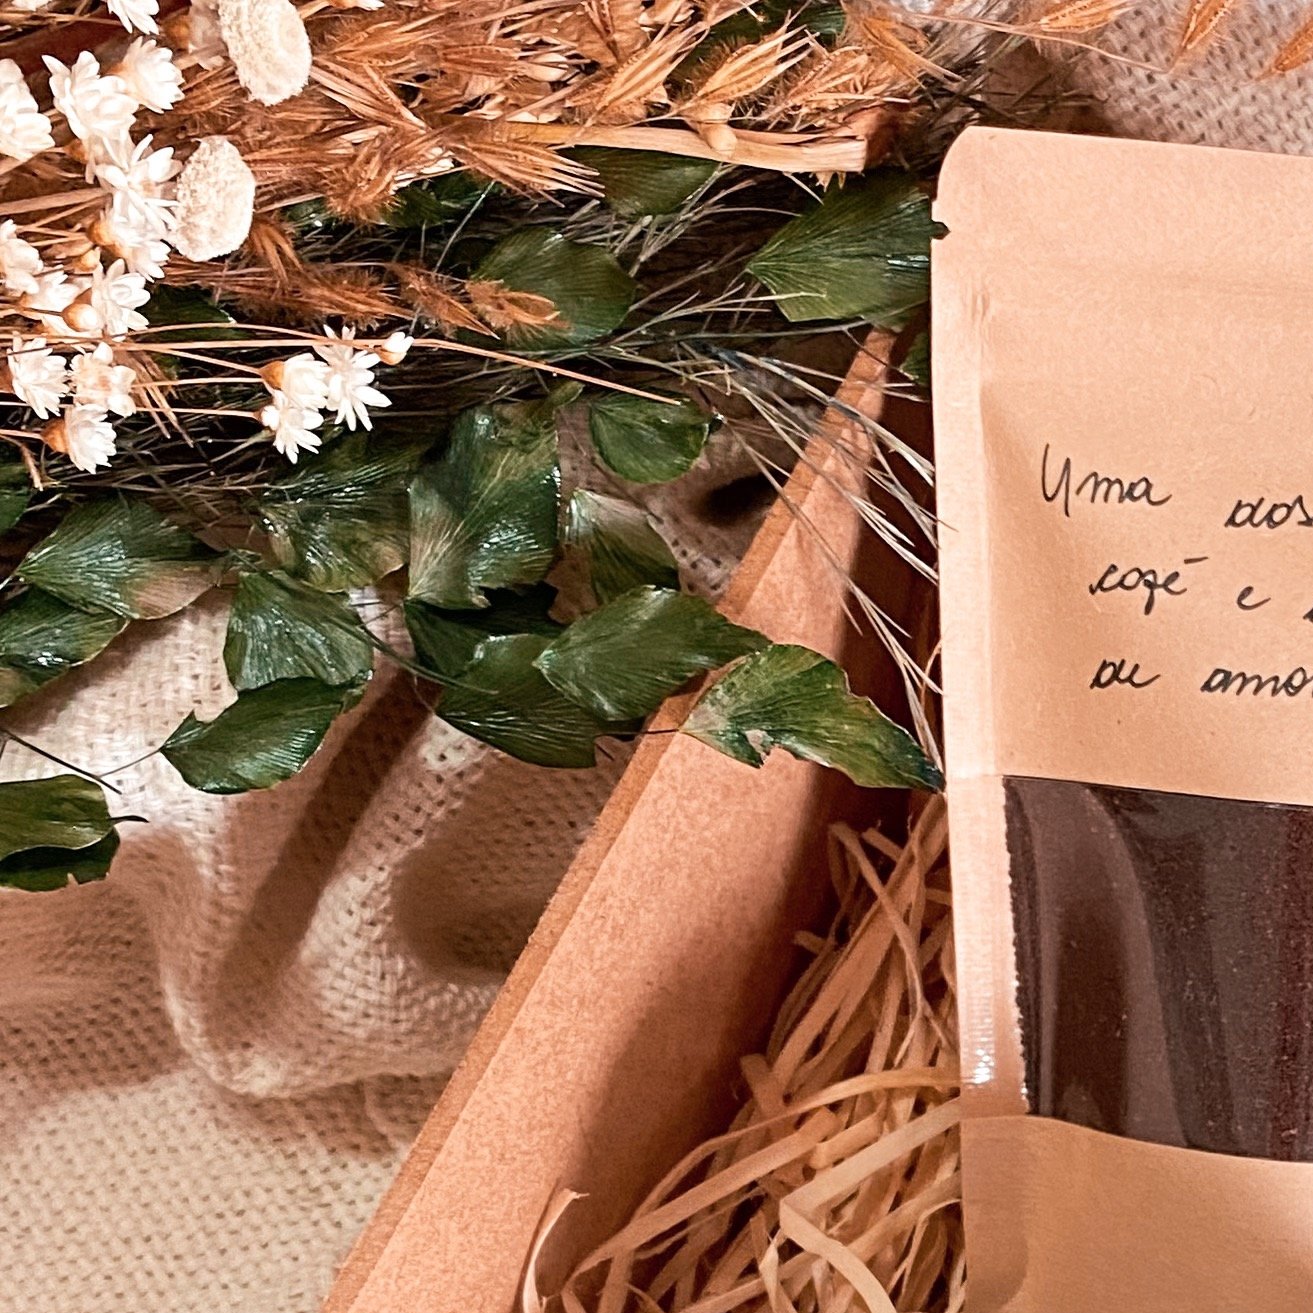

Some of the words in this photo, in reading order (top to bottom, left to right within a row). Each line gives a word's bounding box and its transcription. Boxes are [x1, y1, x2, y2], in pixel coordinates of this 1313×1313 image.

[1041, 443, 1173, 518] Uma
[1236, 585, 1272, 611] e
[1089, 658, 1161, 690] de
